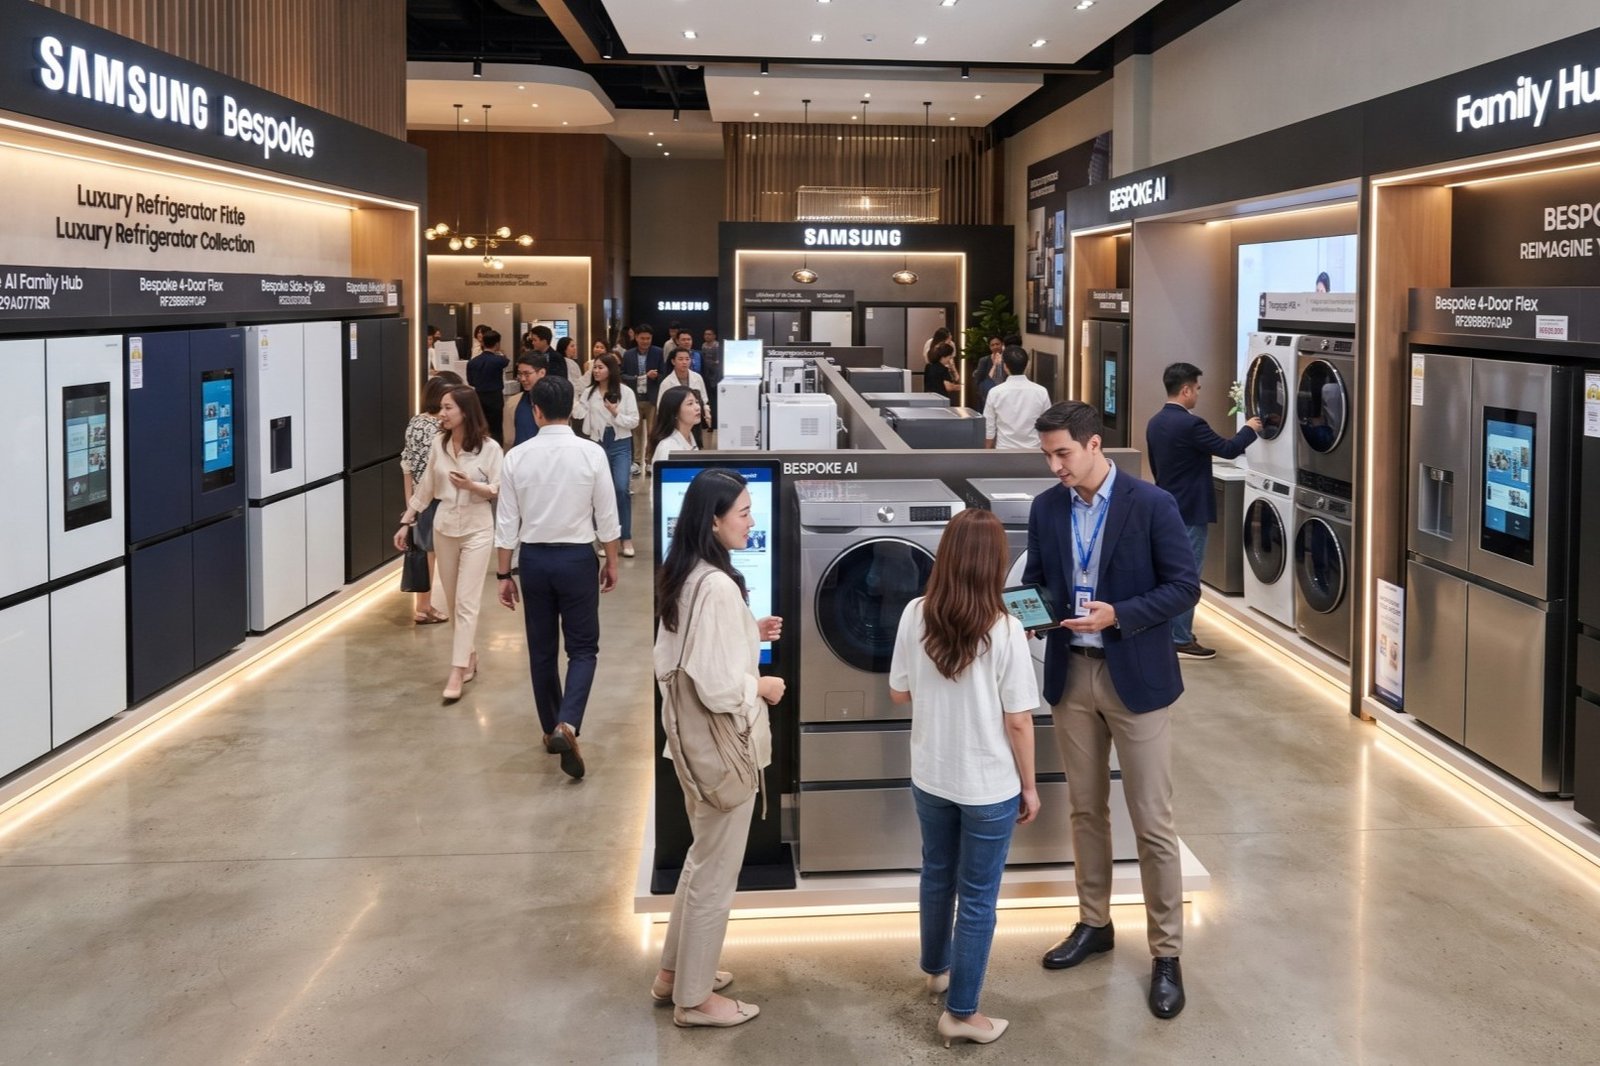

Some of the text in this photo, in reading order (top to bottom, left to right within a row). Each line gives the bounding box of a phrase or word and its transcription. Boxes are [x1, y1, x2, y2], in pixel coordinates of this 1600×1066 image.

[40, 36, 315, 159] SAMSUNG Bespoke
[1456, 76, 1552, 132] Family
[77, 184, 132, 218] Luxury
[136, 193, 217, 224] Refrigerator
[1110, 176, 1166, 212] BESPOKE AI
[56, 216, 255, 253] Luxury Refrigerator Collection
[804, 228, 902, 246] SAMSUNG
[1520, 238, 1593, 259] REIMAGINE
[4, 273, 83, 295] AI Family Hub
[140, 277, 178, 295] Bespoke
[179, 278, 206, 291] 4-Door
[1435, 296, 1539, 314] Bespoke 4-Door Flex
[783, 462, 858, 474] BESPOKE AI
